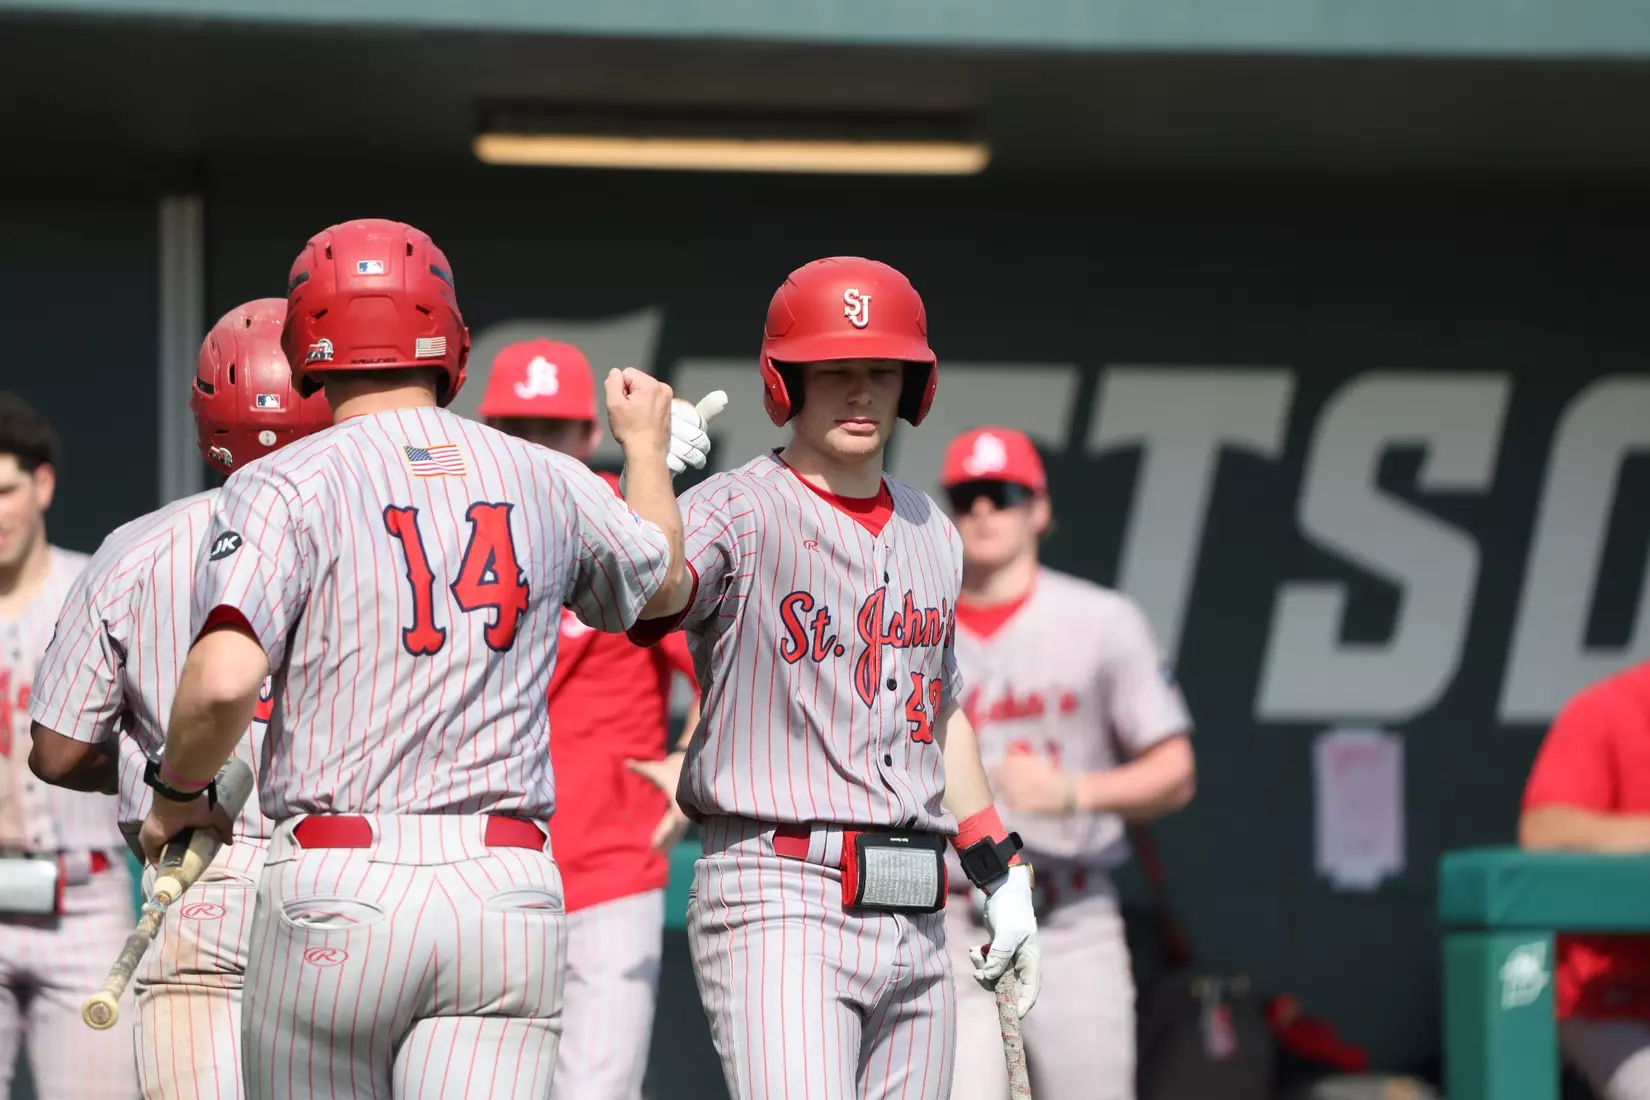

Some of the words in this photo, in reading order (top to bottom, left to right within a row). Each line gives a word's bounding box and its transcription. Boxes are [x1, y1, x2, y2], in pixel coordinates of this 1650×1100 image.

[843, 288, 872, 329] SJ
[211, 535, 239, 556] JK
[383, 501, 530, 657] 14
[780, 590, 845, 665] St.
